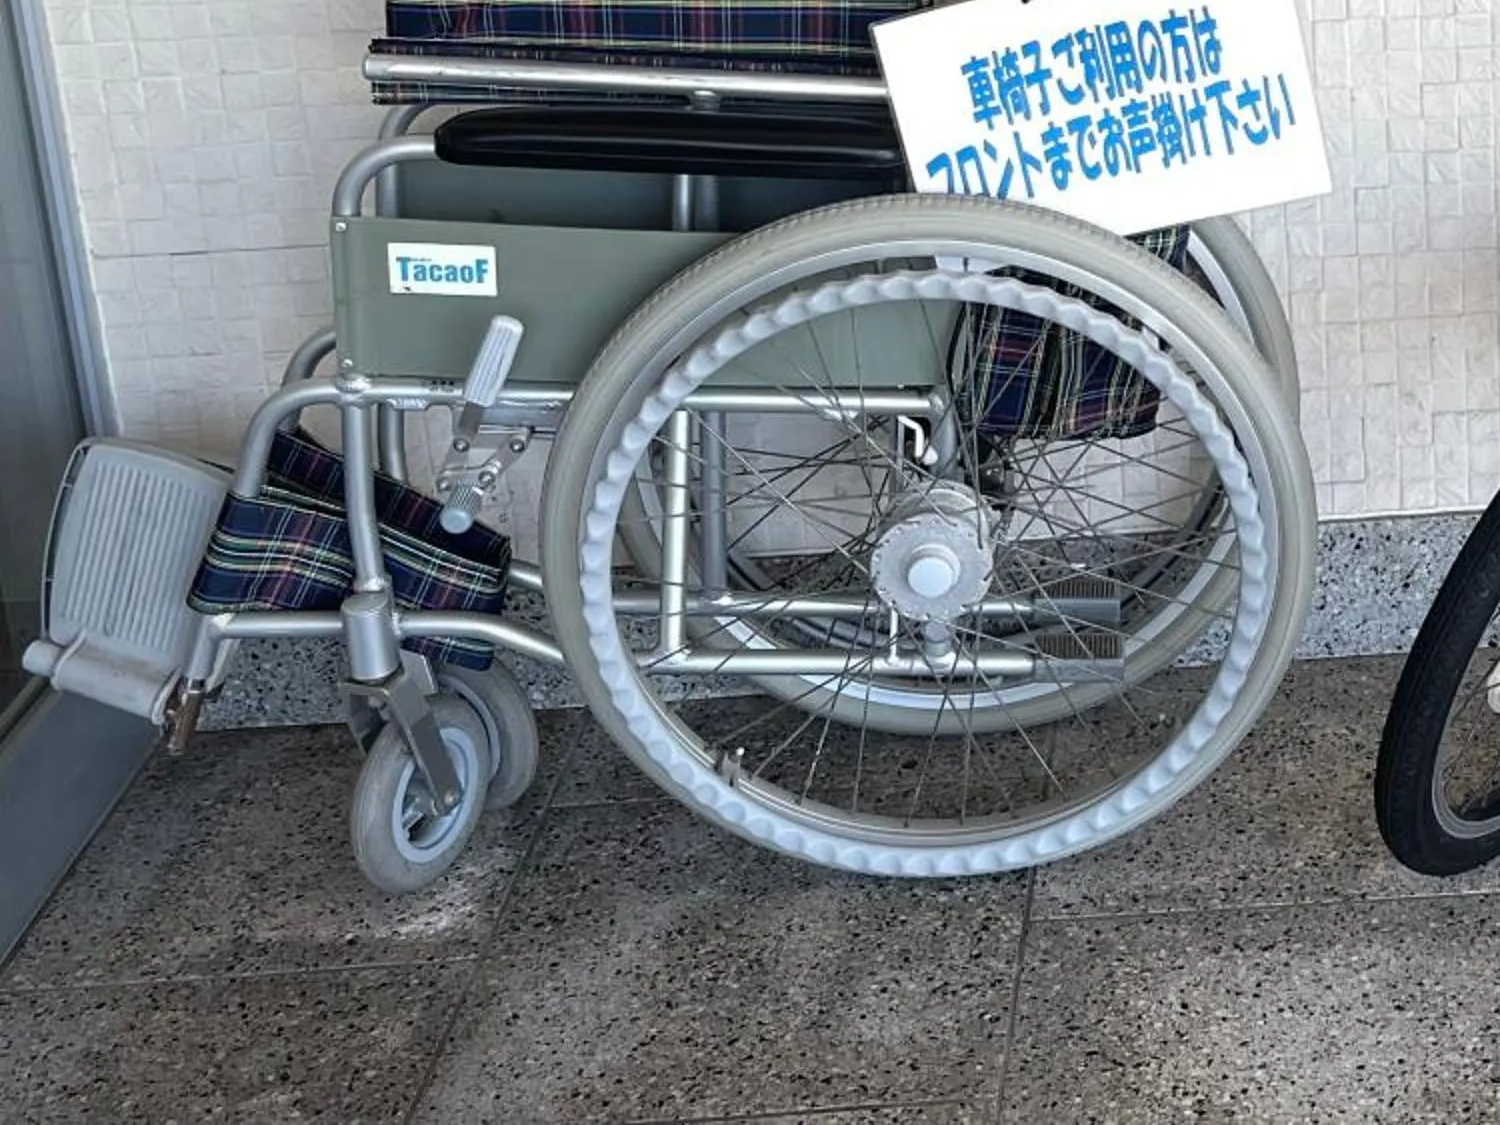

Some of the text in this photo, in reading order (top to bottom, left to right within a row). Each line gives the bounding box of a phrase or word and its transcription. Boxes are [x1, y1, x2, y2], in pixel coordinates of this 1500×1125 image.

[961, 6, 1222, 130] 車椅子ご利用の方は
[926, 73, 1296, 199] フロントまでお声掛け下さい
[396, 256, 489, 284] TacaoF
